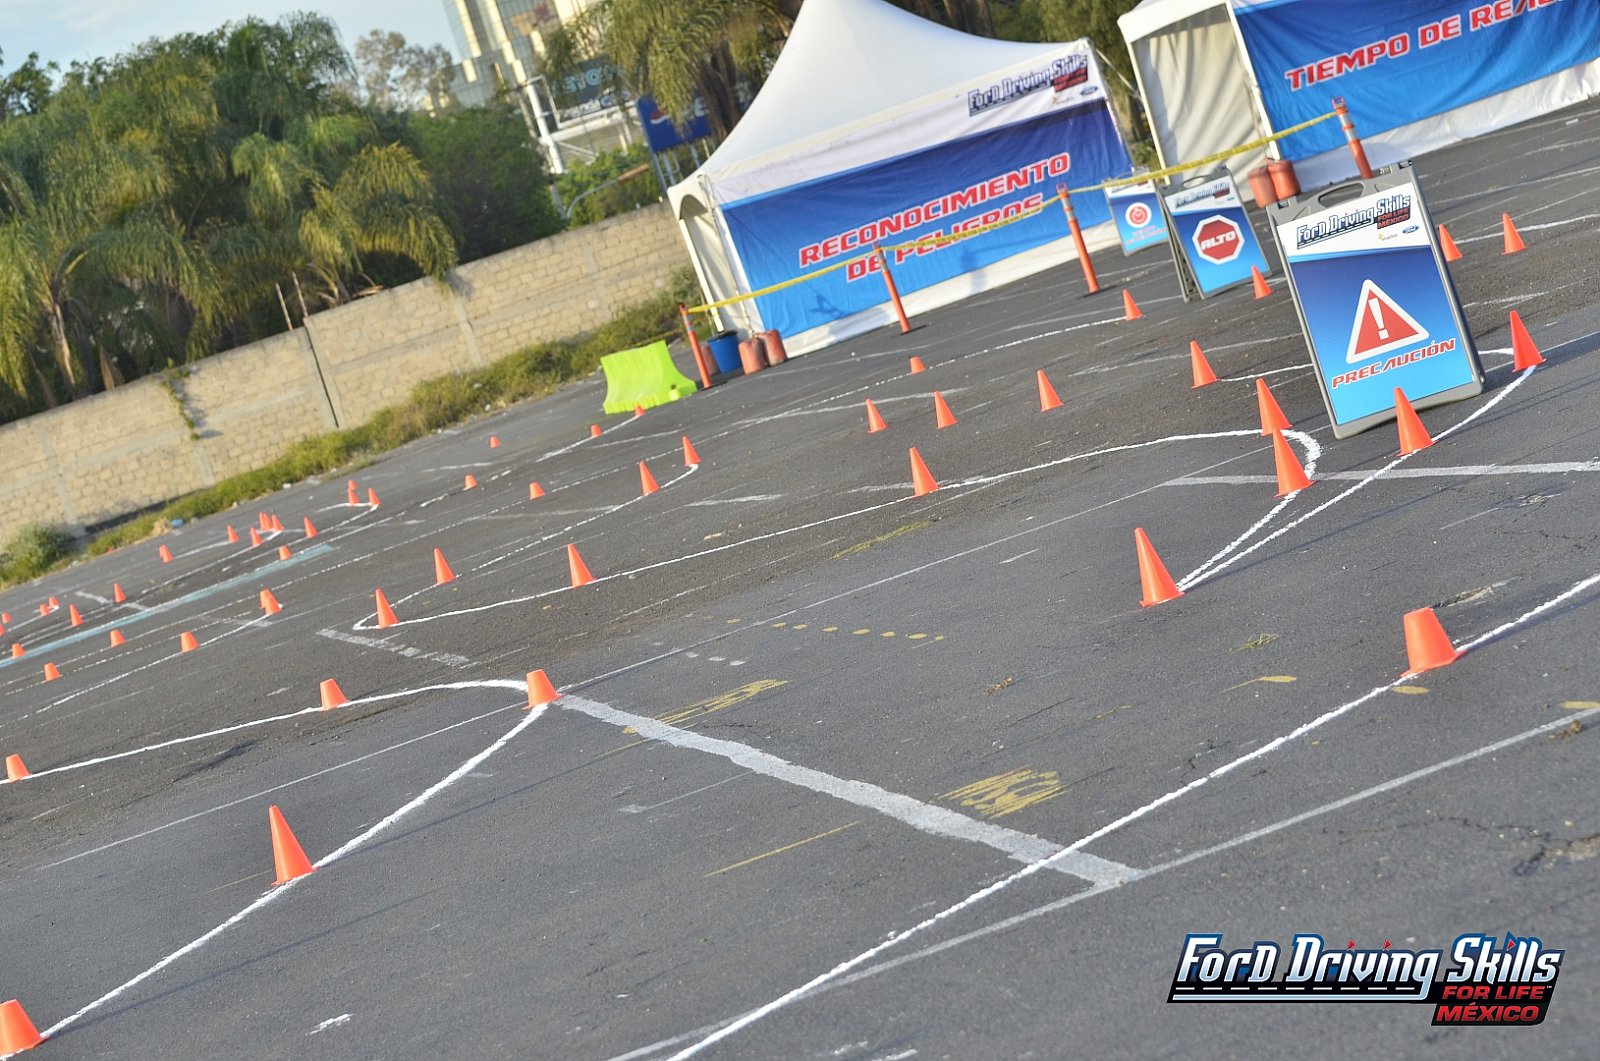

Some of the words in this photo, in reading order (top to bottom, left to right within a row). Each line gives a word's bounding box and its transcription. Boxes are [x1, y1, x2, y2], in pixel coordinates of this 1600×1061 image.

[1285, 32, 1410, 92] TIEMPO
[1418, 14, 1461, 49] DE
[1001, 70, 1051, 98] Driving
[1052, 54, 1088, 78] Skills
[799, 152, 1071, 268] RECONOCIMIENTO
[1329, 207, 1375, 234] Driving
[1376, 194, 1411, 217] Skills
[1200, 230, 1237, 251] ALTO
[846, 253, 882, 282] DE
[1331, 338, 1456, 389] PRECAUCIÓN
